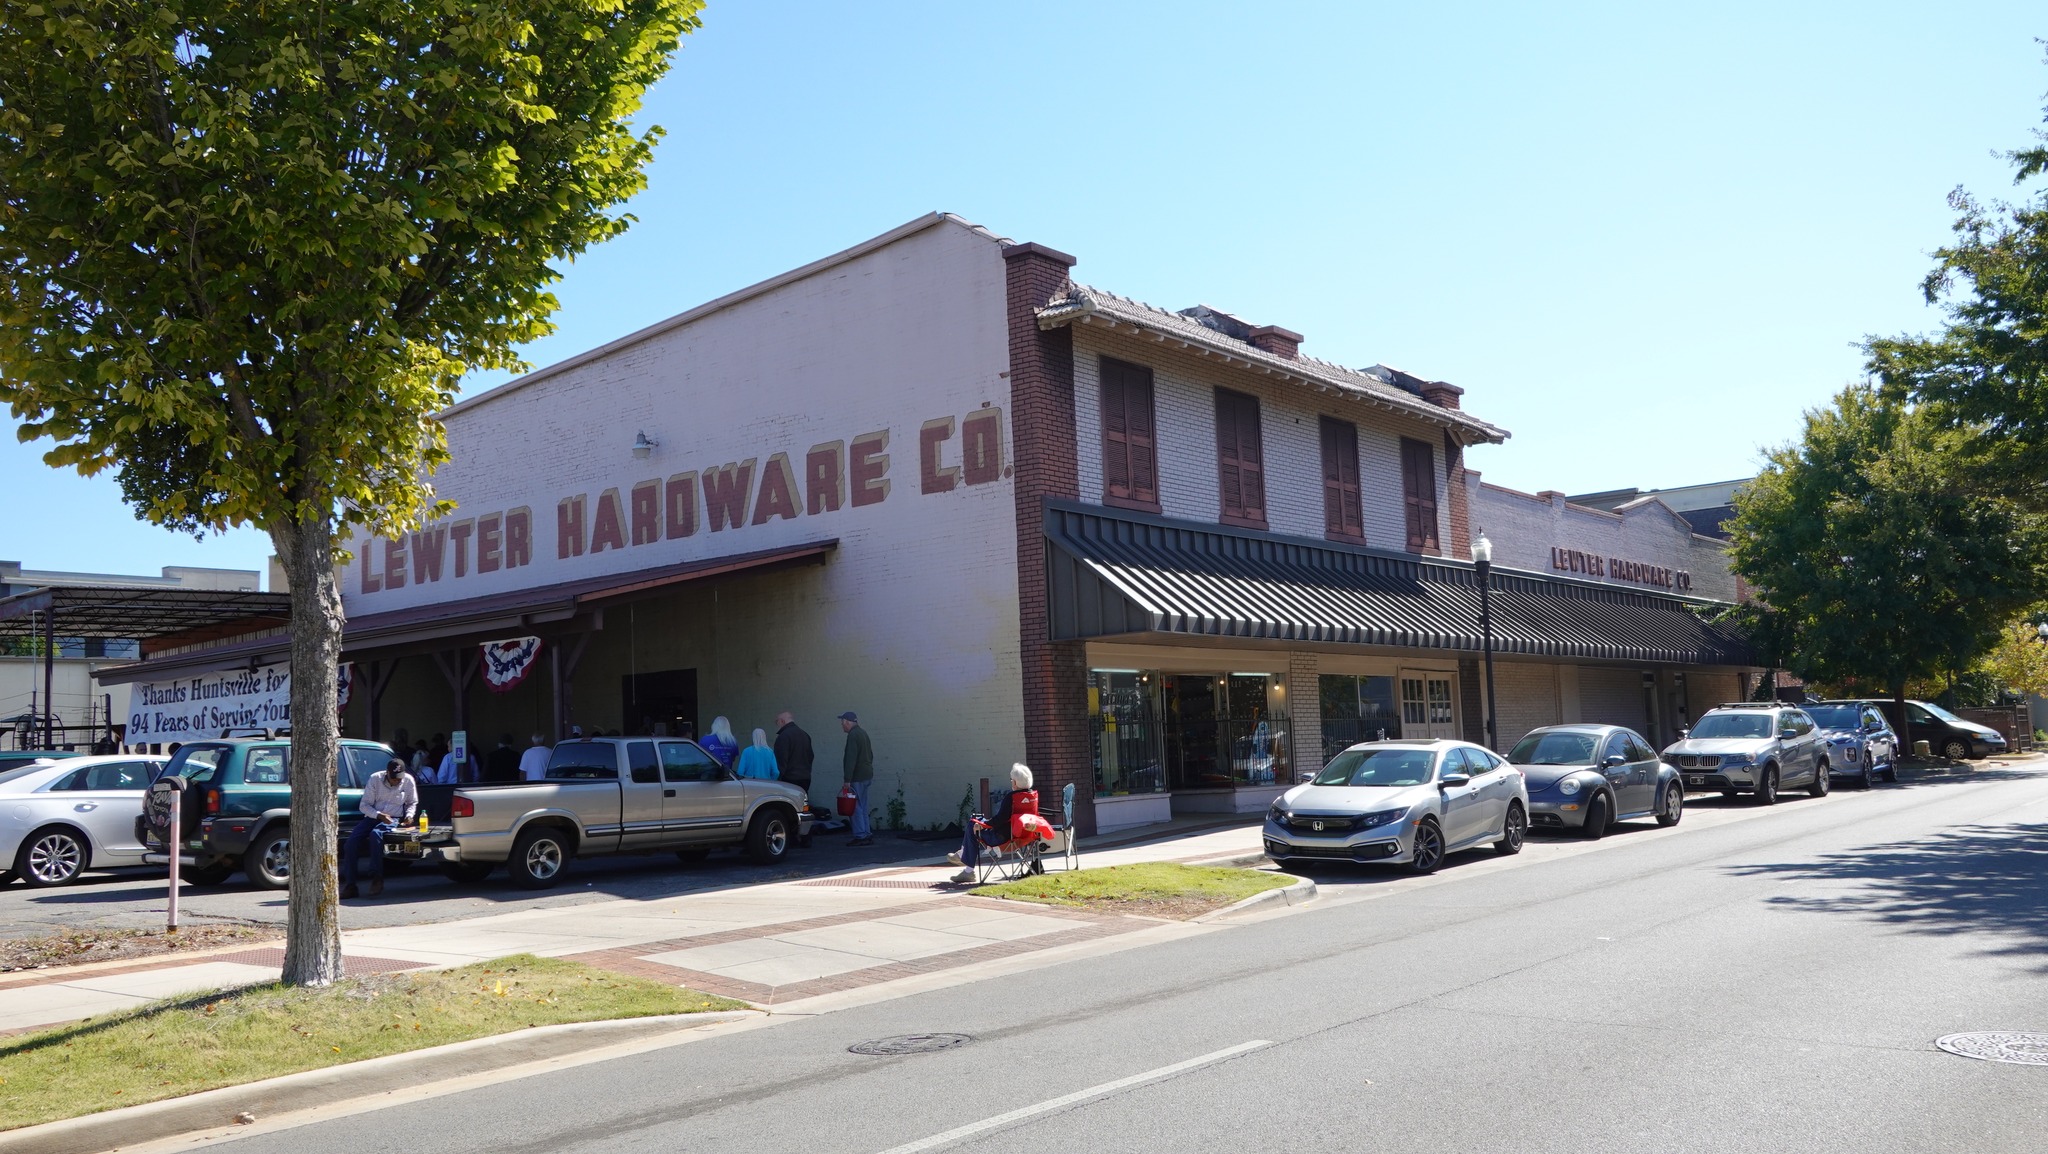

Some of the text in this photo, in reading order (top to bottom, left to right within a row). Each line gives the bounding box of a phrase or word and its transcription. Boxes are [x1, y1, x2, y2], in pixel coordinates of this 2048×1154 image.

[361, 406, 1014, 594] LEWTER HARDWARE CO.
[1551, 547, 1604, 576] LEWTER
[1609, 557, 1673, 588] HARDWARE
[142, 668, 289, 706] Thanks Huntsville for
[131, 713, 149, 735] 94
[154, 712, 189, 733] Years
[193, 706, 207, 730] of
[211, 703, 262, 728] Serving
[152, 791, 172, 805] RAV
